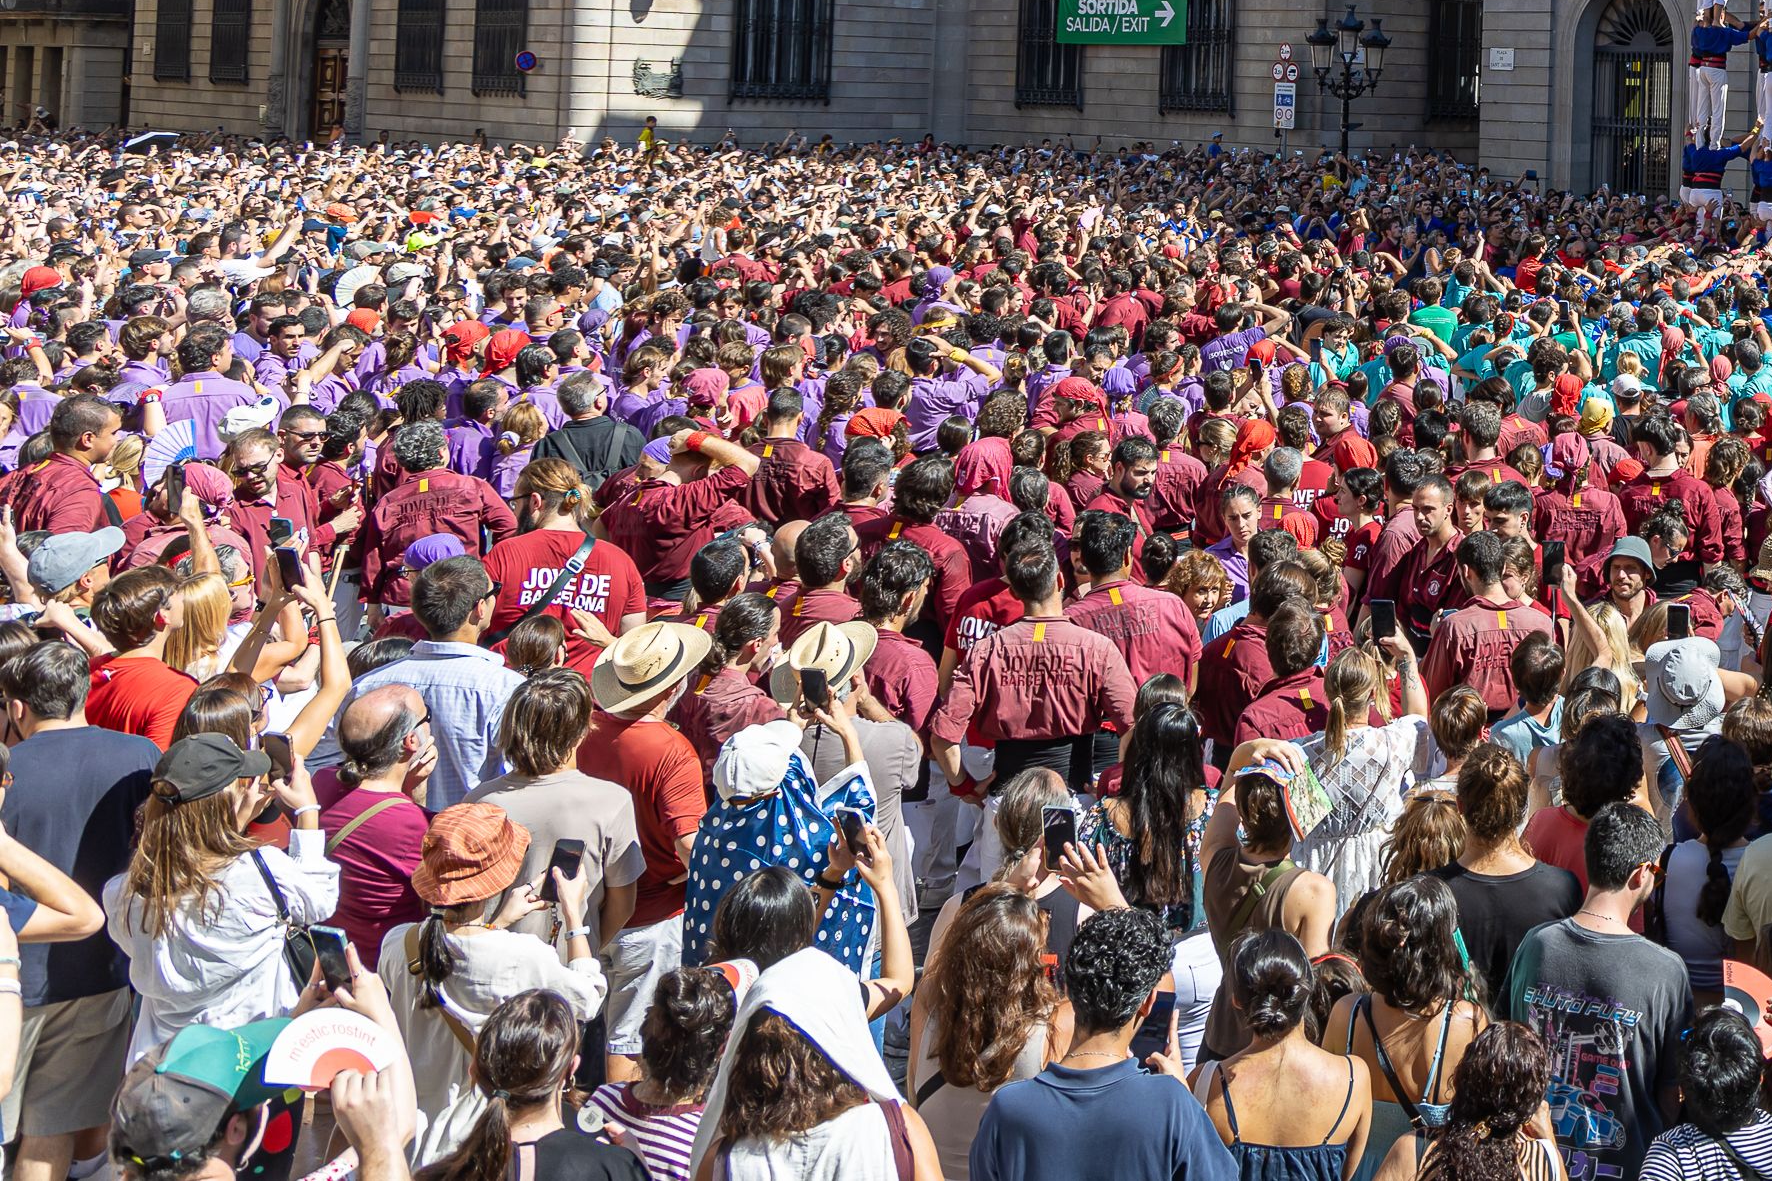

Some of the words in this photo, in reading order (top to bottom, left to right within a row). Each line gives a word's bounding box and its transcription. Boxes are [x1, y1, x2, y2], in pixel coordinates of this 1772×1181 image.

[1066, 17, 1110, 32] SALIDA
[1122, 17, 1150, 32] EXIT
[580, 573, 611, 596] DE
[1001, 656, 1046, 673] JOVE
[1050, 656, 1073, 673] DE
[1524, 986, 1585, 1014] SHUTO
[289, 1024, 330, 1062] m'estic
[333, 1023, 377, 1047] rostint
[1581, 1052, 1609, 1065] GAME
